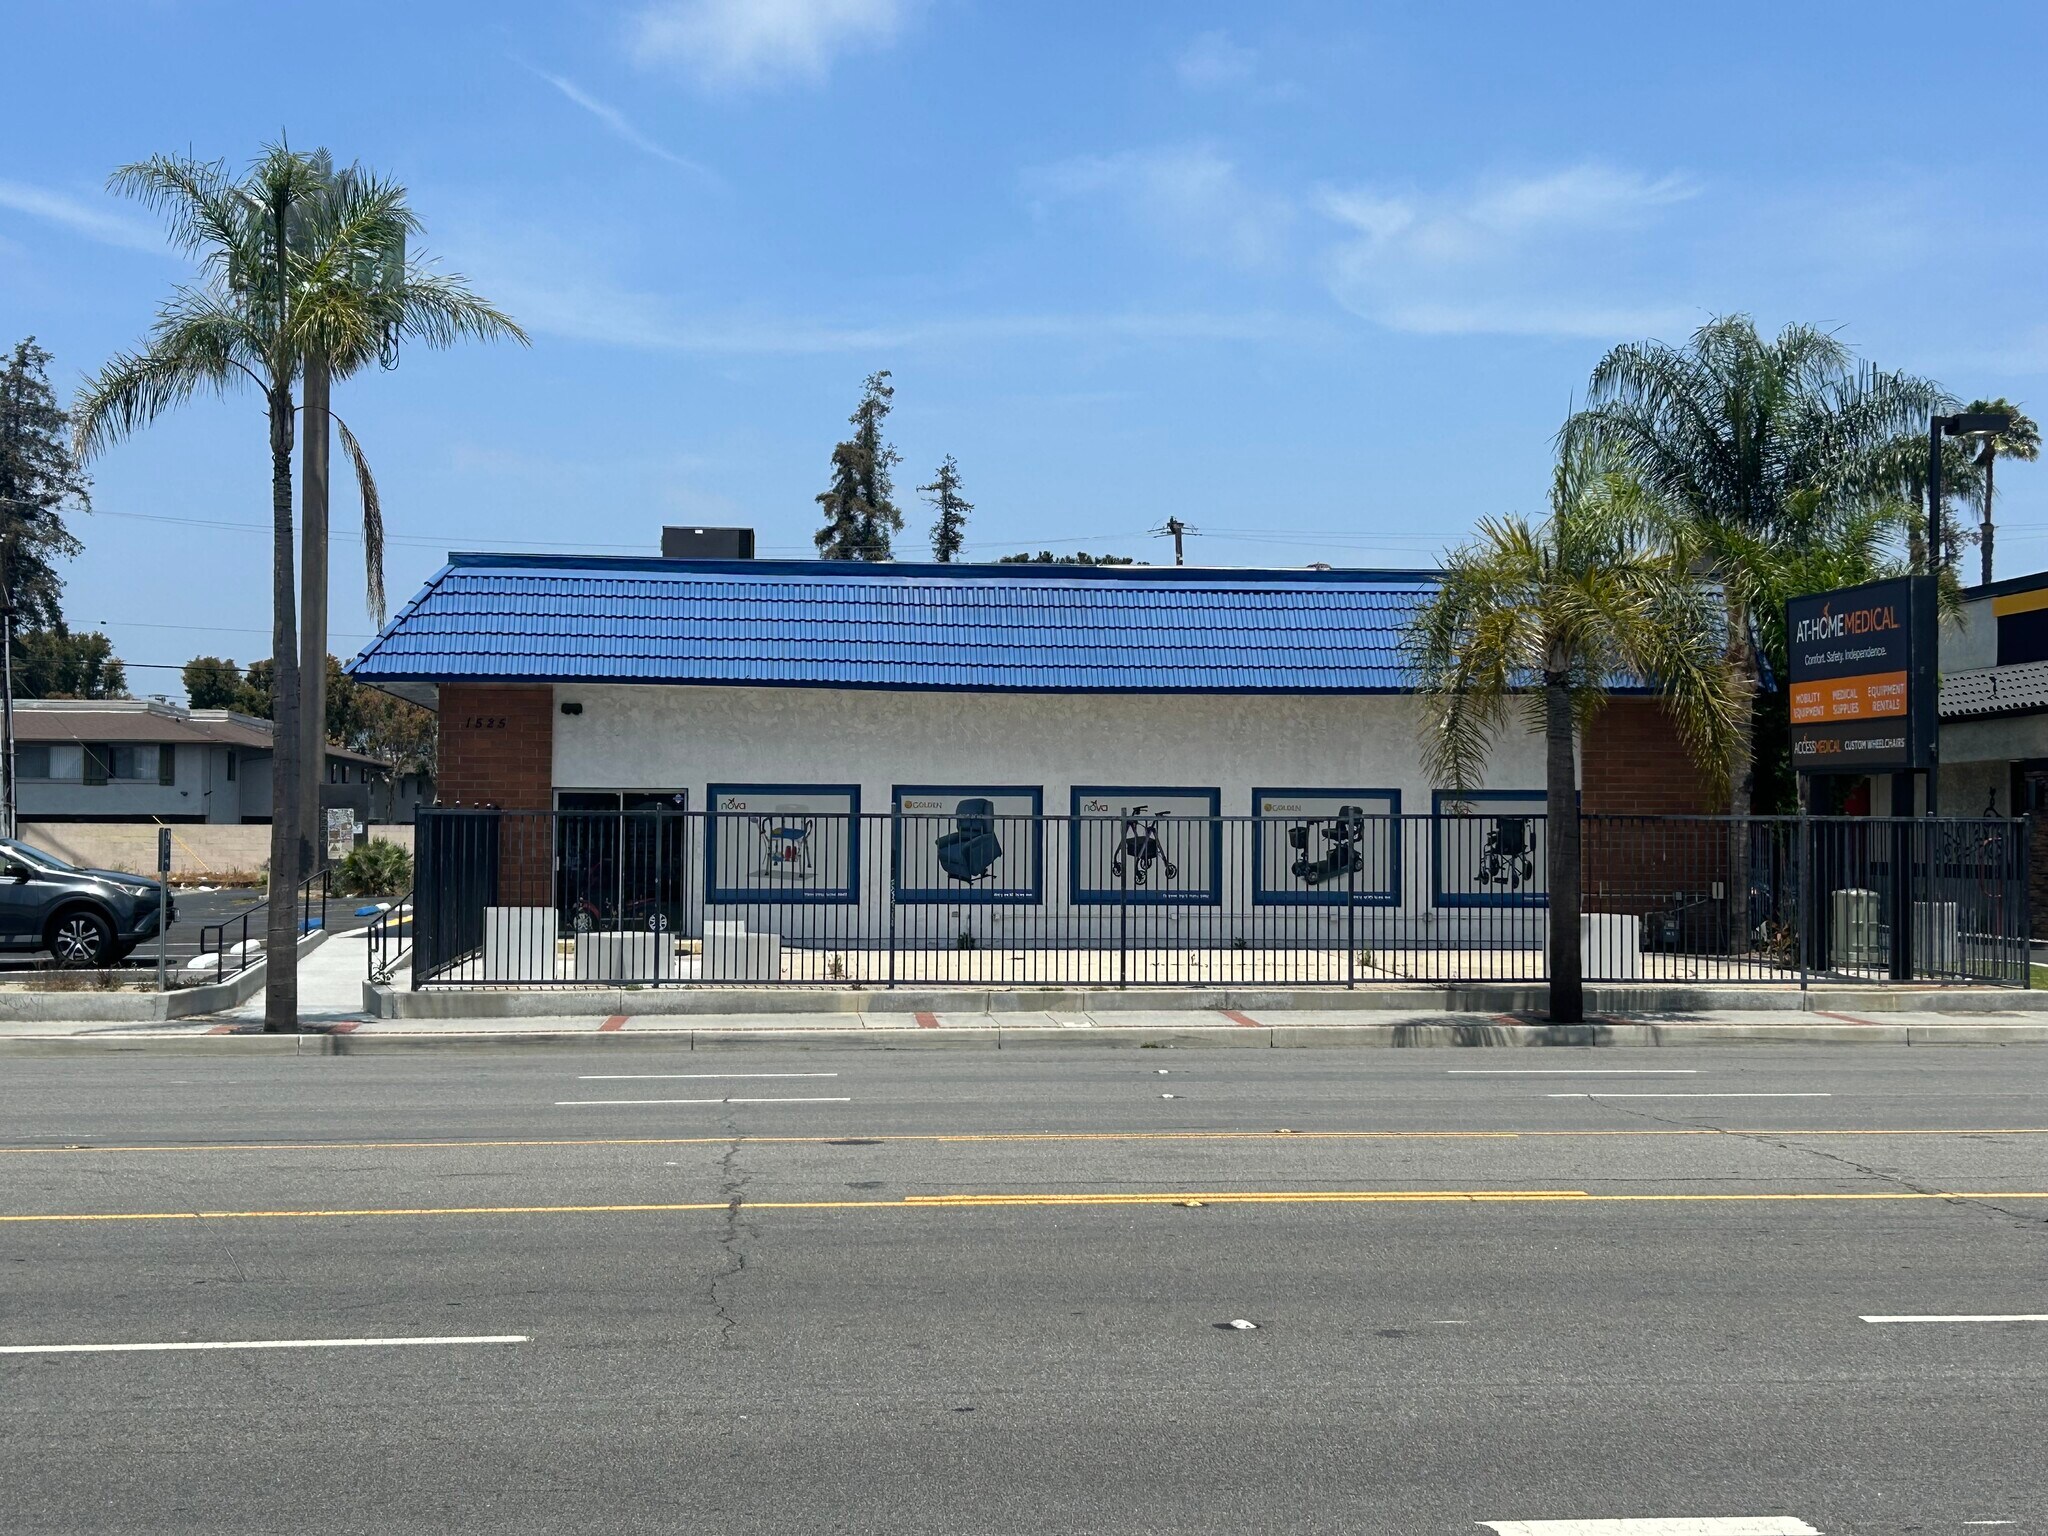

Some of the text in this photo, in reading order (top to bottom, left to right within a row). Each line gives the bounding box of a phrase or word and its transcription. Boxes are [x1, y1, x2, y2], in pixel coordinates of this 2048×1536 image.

[1832, 689, 1858, 701] MEDICAL
[1867, 683, 1905, 699] EQUIPMENT
[1832, 702, 1859, 715] SUPPLIES
[1872, 699, 1900, 712] RENTALS
[1844, 740, 1866, 751] CUSTOM
[1867, 737, 1905, 750] WHEELCHAIRS
[912, 801, 943, 809] GOLDEN
[1272, 804, 1302, 812] GOLDEN
